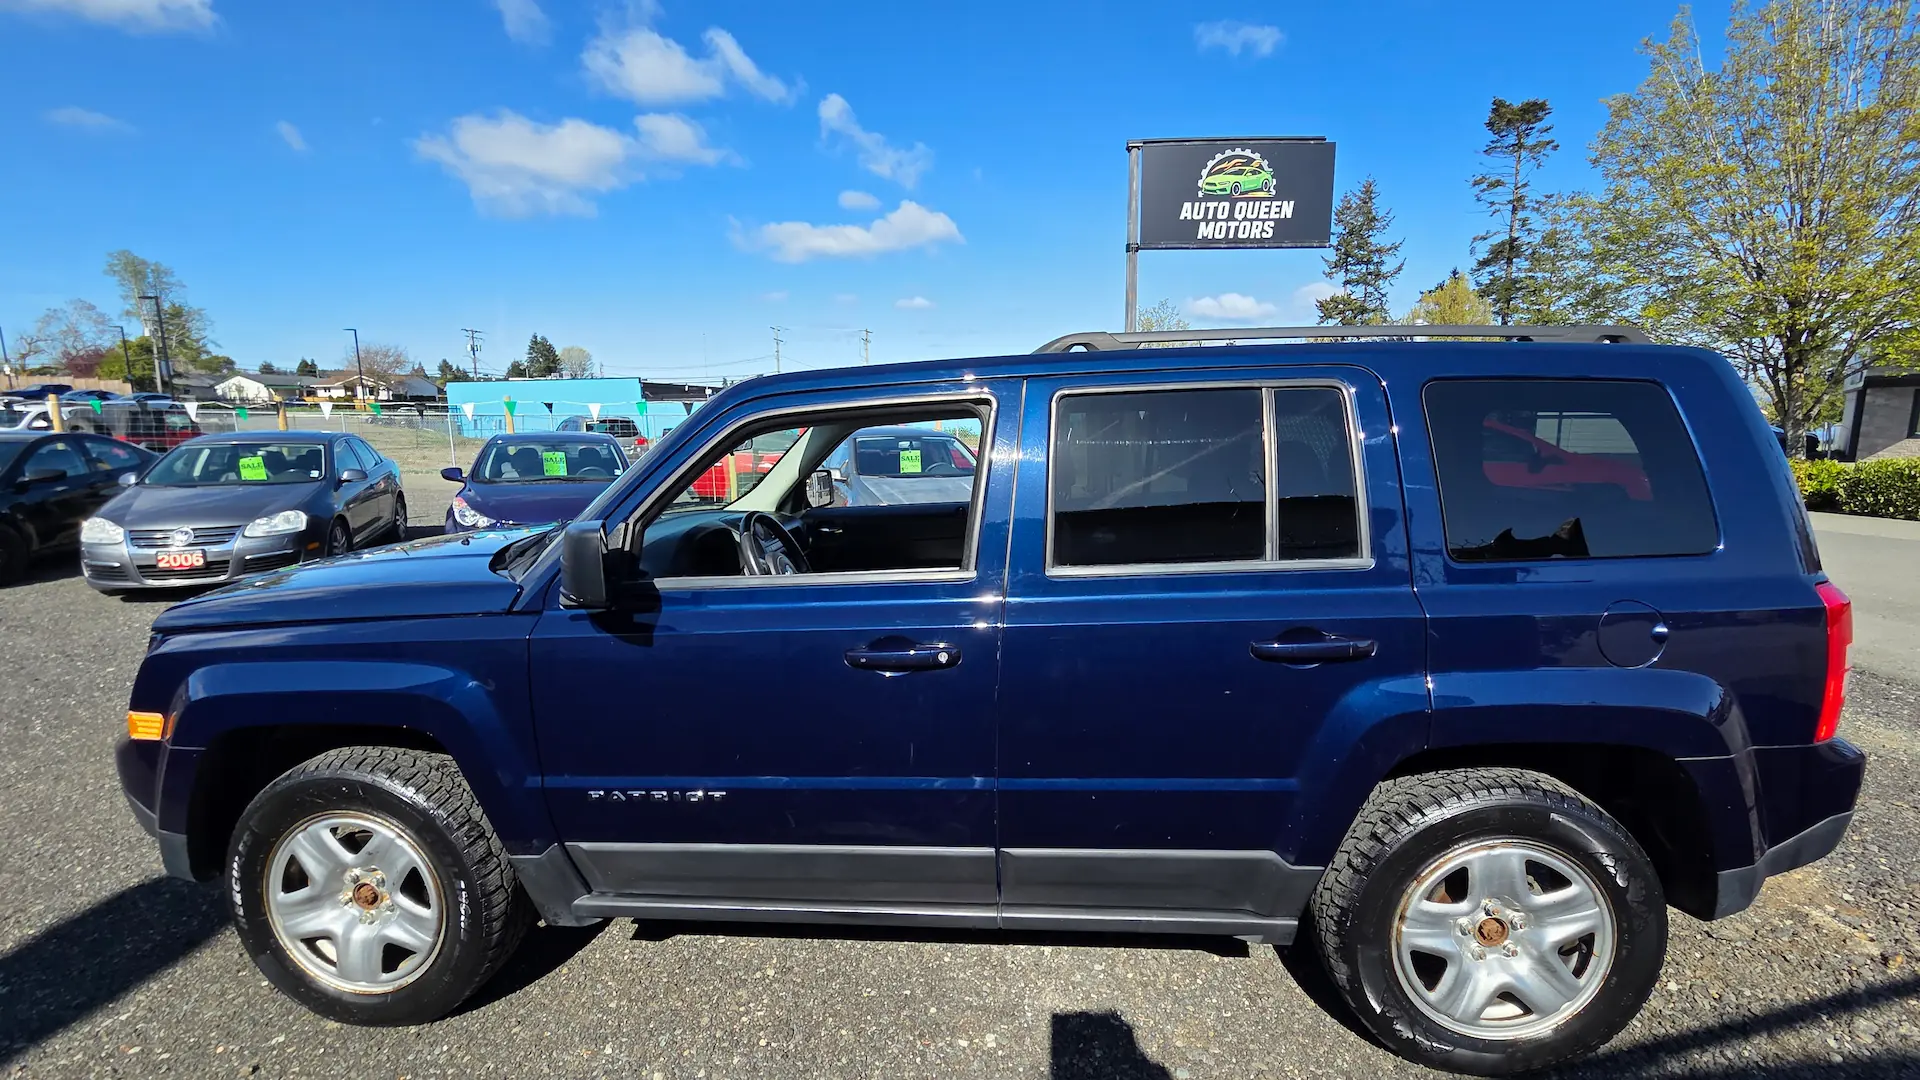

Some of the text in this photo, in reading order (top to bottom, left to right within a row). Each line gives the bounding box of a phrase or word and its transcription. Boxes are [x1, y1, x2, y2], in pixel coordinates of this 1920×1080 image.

[1179, 200, 1295, 220] AUTO QUEEN
[1197, 220, 1275, 239] MOTORS
[240, 462, 264, 470] SALE
[157, 553, 204, 568] 2006
[587, 790, 727, 802] PATRIOT
